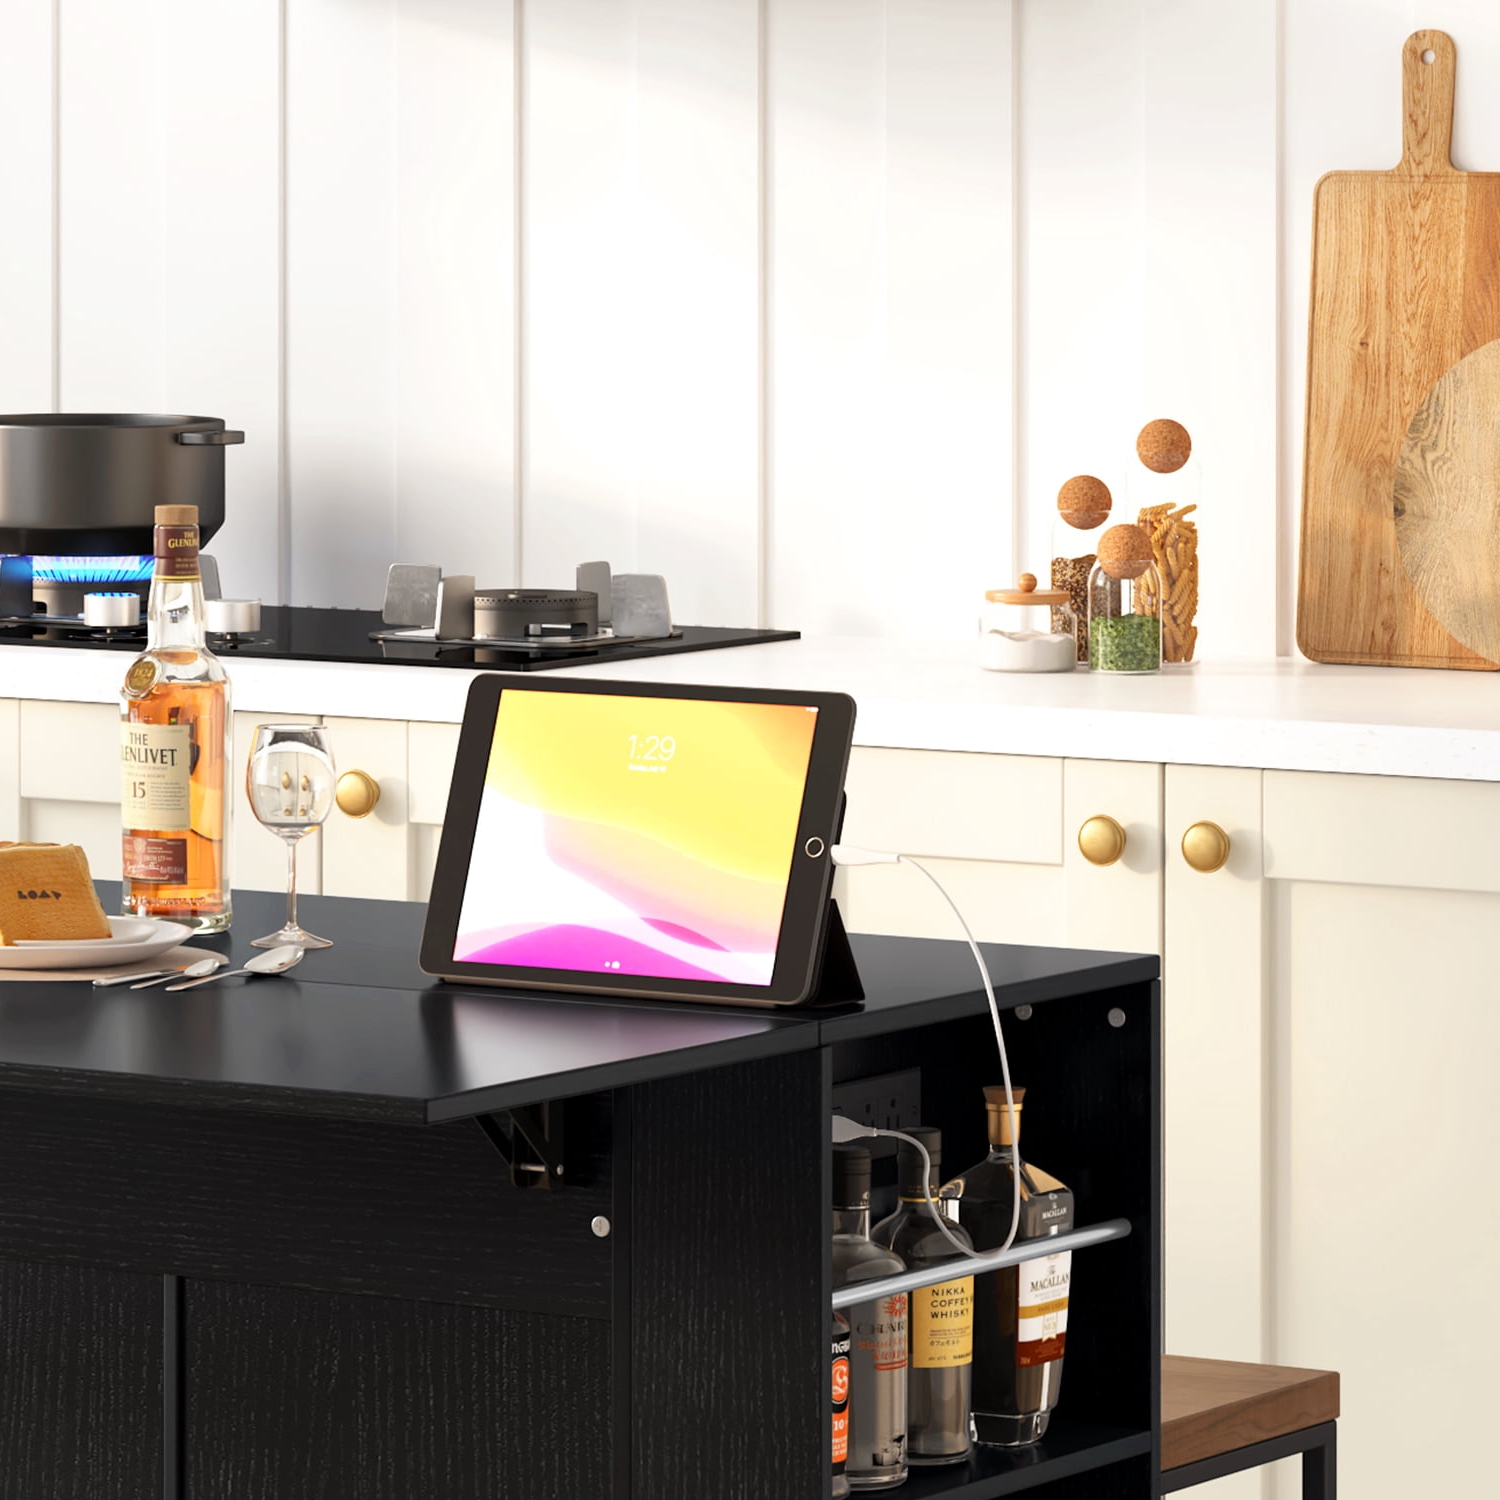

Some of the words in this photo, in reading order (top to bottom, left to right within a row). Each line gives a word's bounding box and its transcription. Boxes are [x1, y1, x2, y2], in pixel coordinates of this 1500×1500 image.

[129, 732, 148, 745] THE
[121, 745, 177, 766] LENLIVET
[628, 735, 676, 761] 1:29
[132, 781, 146, 799] 15
[932, 1287, 965, 1296] NIKKA
[931, 1308, 969, 1319] WHISKY
